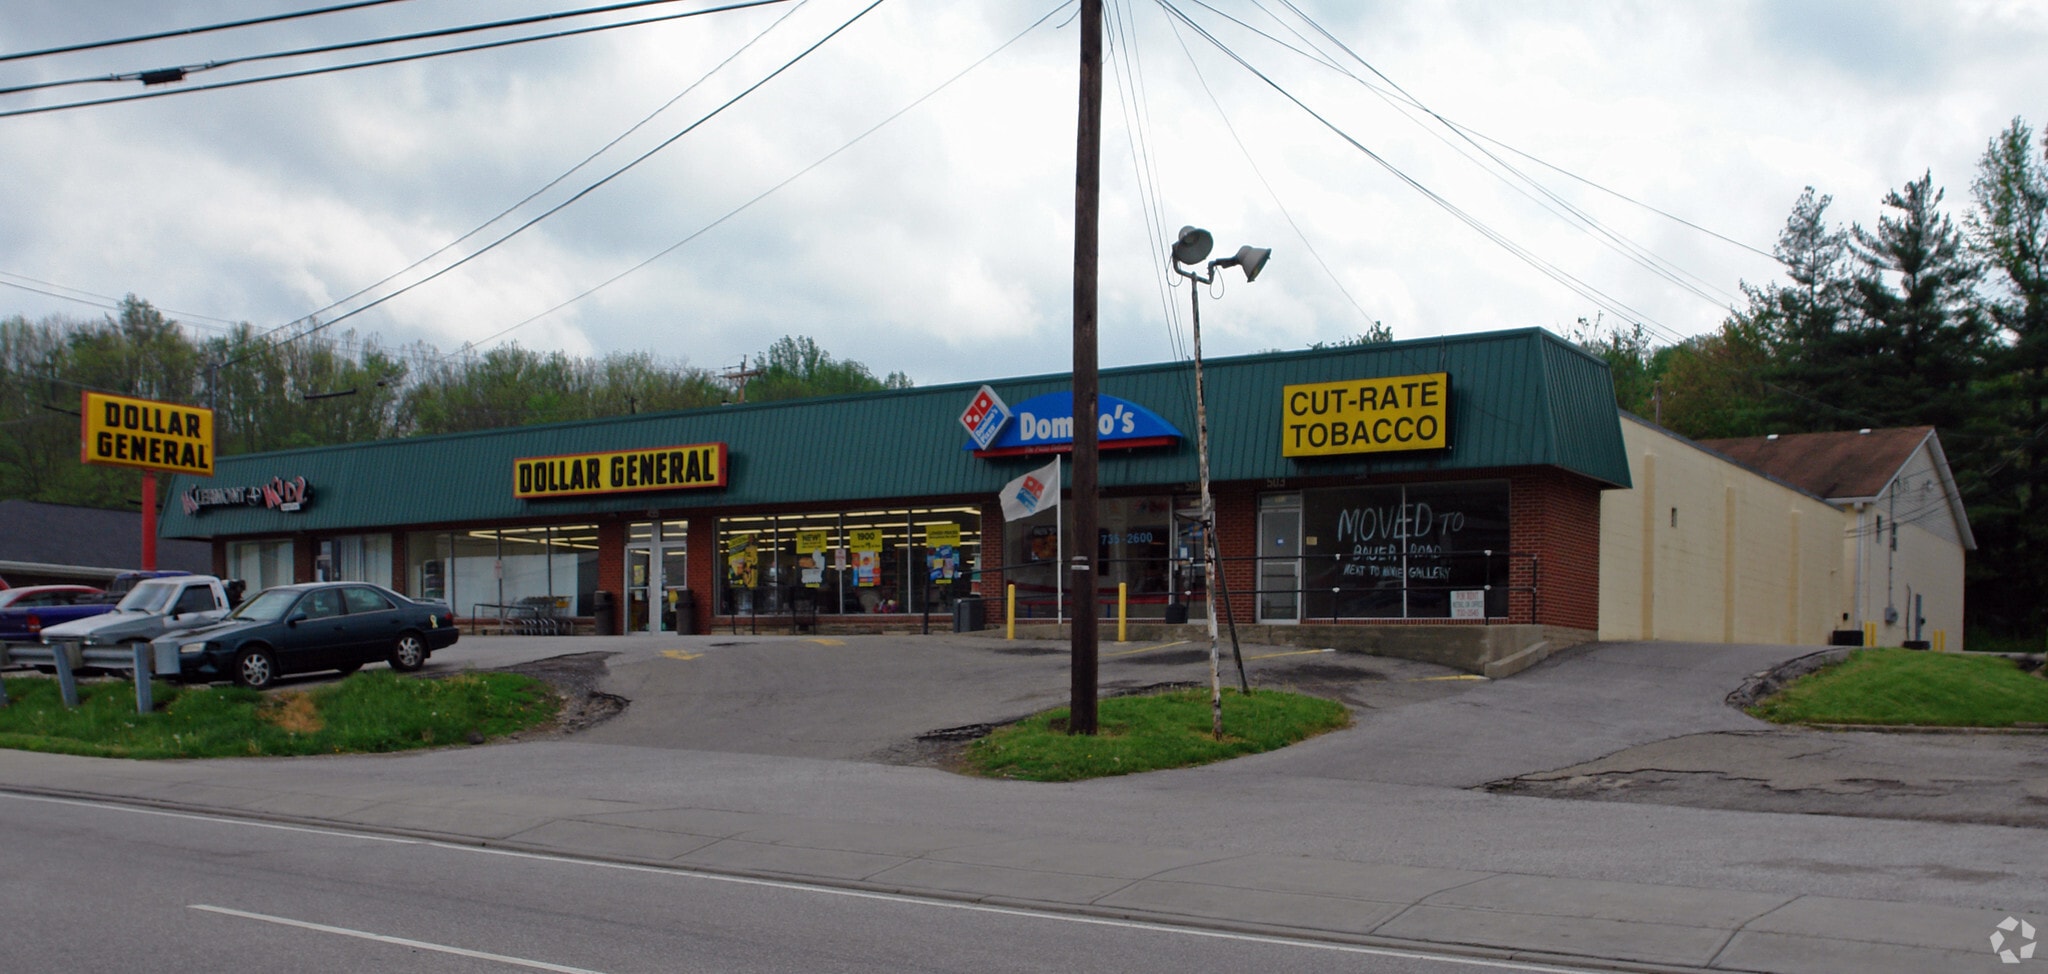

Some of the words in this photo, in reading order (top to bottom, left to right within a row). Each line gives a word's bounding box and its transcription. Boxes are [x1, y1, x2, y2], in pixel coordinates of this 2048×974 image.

[1290, 381, 1438, 416] CUT-RATE
[105, 402, 200, 438] DOLLAR
[1020, 404, 1135, 441] Domo's
[1290, 415, 1438, 448] TOBACCO
[97, 432, 208, 469] GENERAL
[519, 458, 600, 493] DOLLAR
[610, 449, 714, 487] GENERAL
[857, 532, 875, 540] 1900
[1337, 503, 1433, 542] MOVED
[1440, 511, 1465, 535] TO
[1409, 543, 1443, 559] ROAD
[1343, 564, 1365, 576] NEXT
[1369, 565, 1380, 577] TO
[1408, 566, 1452, 583] GALLERY
